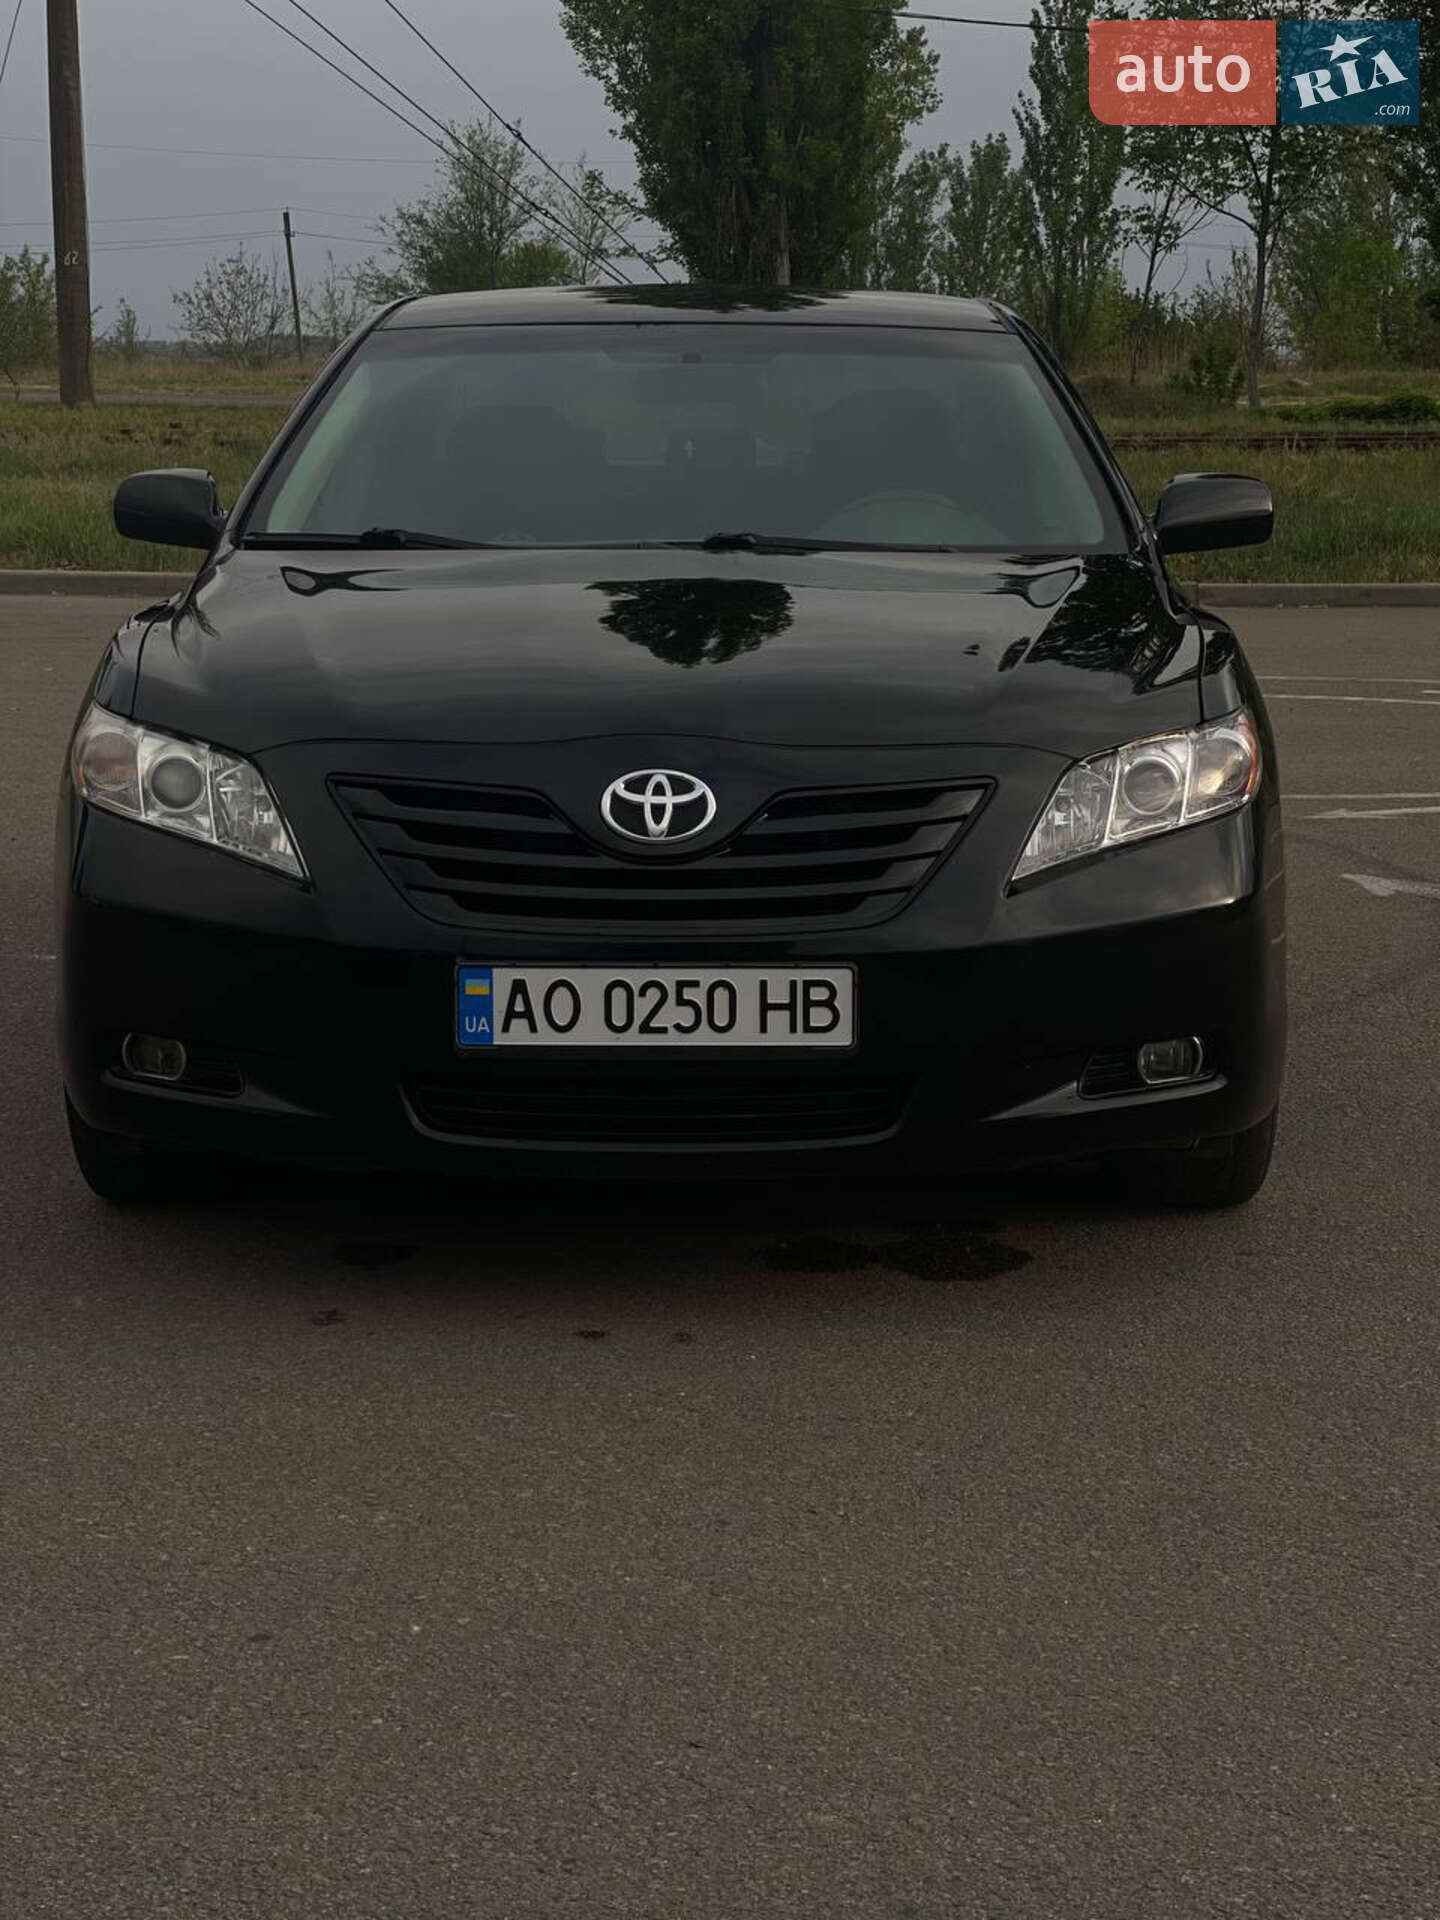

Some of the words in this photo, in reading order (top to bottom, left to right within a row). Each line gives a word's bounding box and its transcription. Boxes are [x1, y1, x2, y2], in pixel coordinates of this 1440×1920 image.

[465, 1015, 490, 1033] UA
[501, 978, 582, 1034] AO
[603, 978, 737, 1034] 0250
[759, 978, 841, 1034] HB
